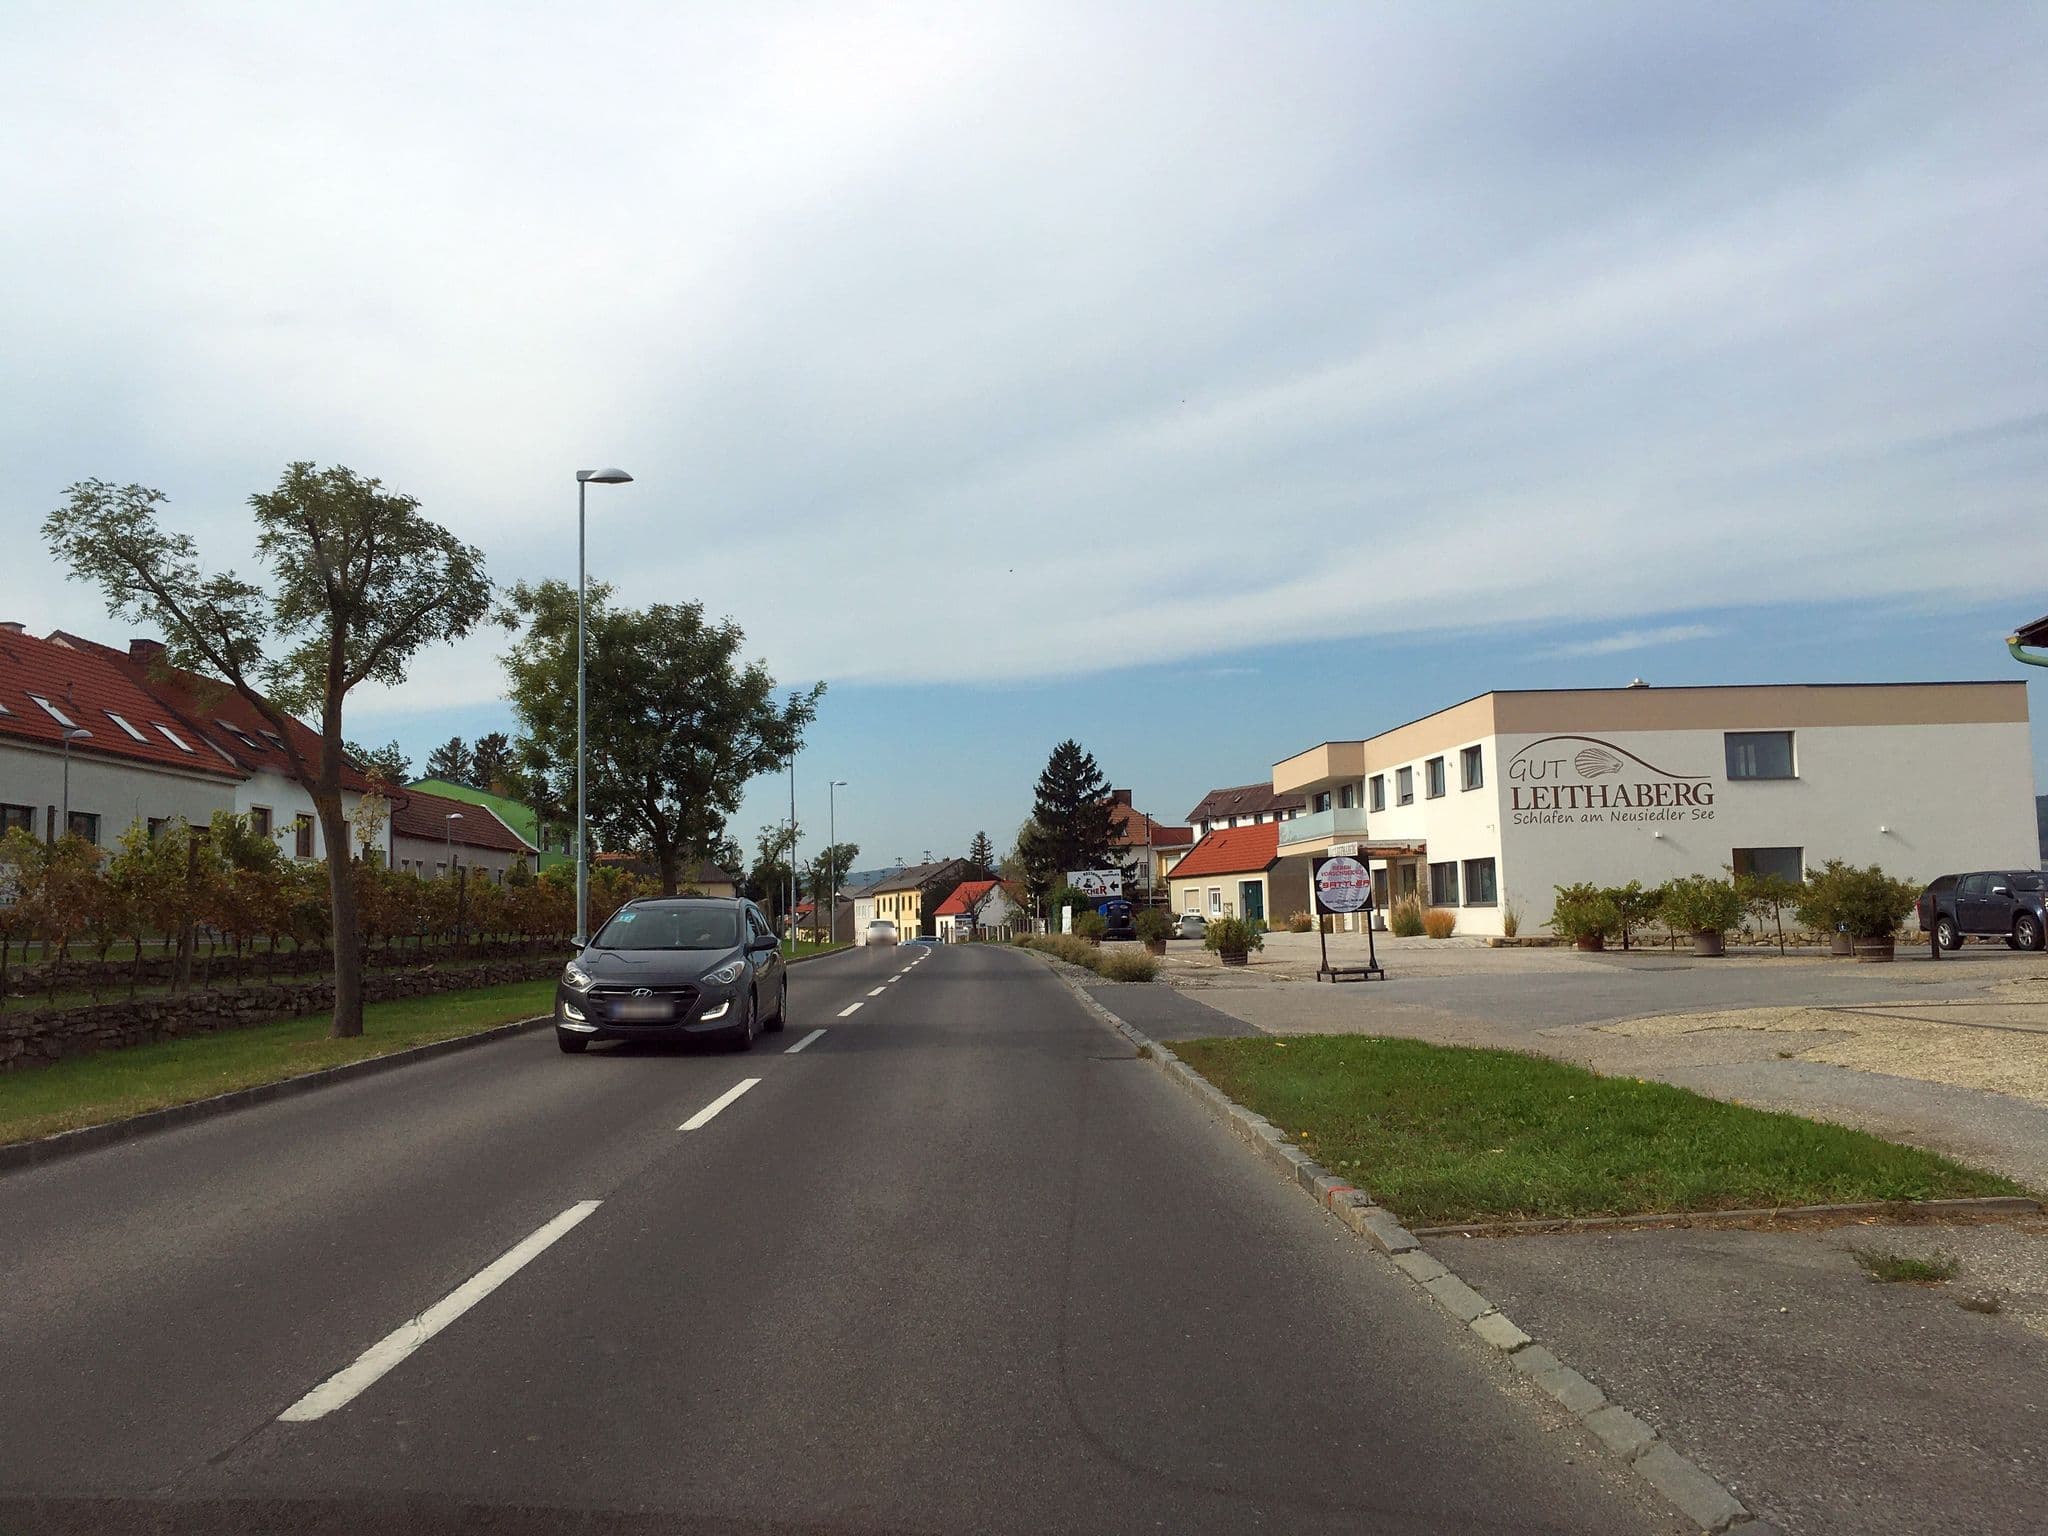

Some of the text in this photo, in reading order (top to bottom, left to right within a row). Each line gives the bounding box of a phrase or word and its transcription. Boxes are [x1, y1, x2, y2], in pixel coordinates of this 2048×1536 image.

[1508, 759, 1567, 782] GUT
[1511, 782, 1715, 810] LEITHABERG
[1513, 808, 1716, 825] Schlafen am Neusiedler See
